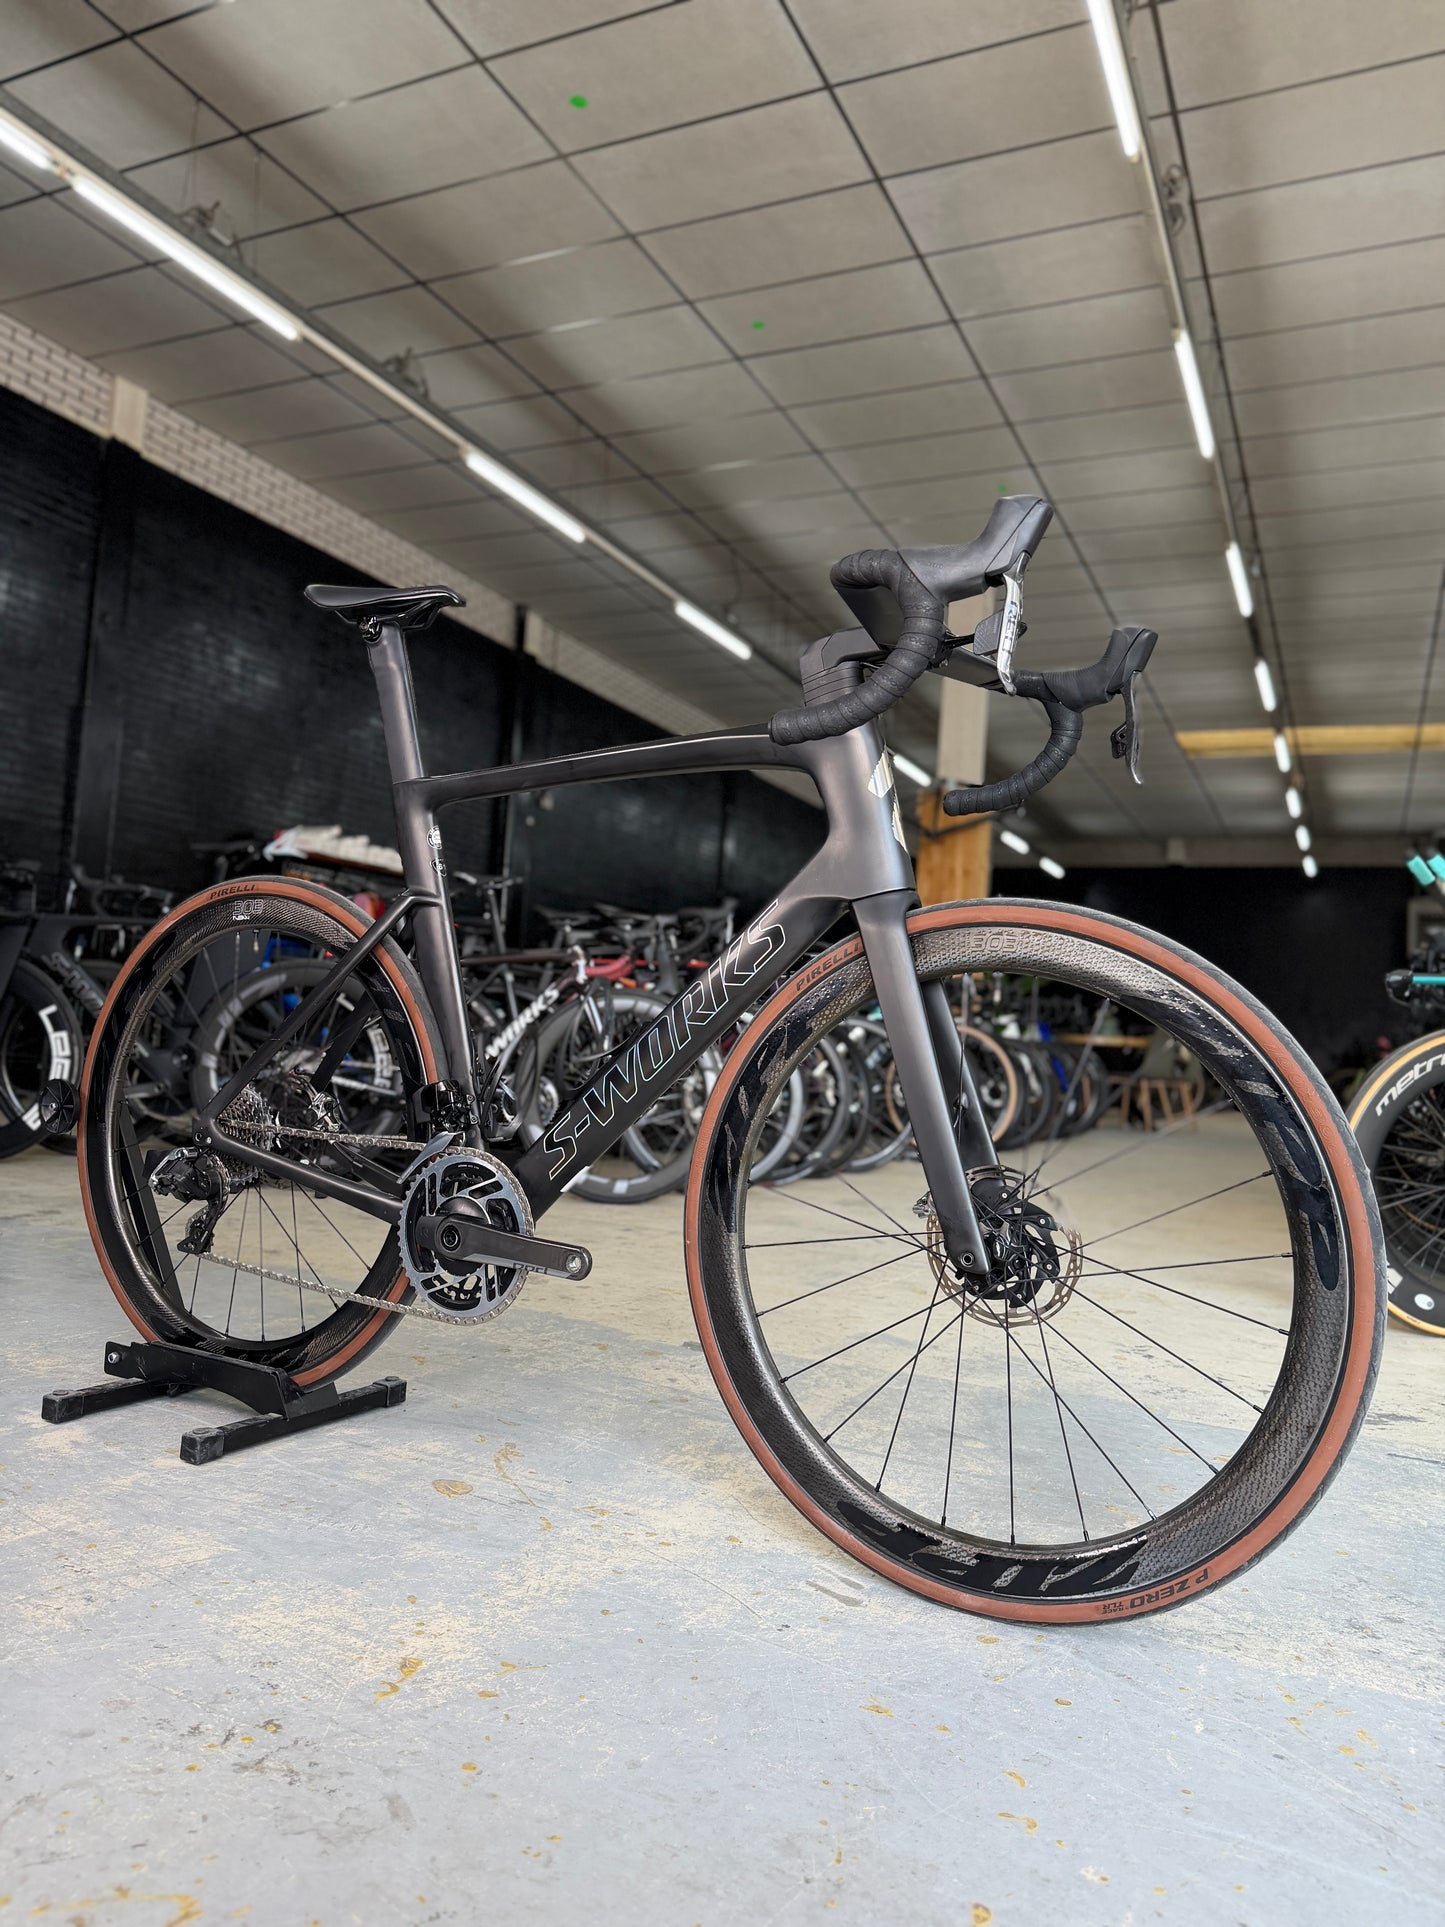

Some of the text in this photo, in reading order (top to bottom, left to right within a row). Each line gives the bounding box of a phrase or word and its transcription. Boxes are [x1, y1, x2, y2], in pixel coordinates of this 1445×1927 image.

[210, 884, 255, 900] PIRELLI
[233, 899, 263, 916] 303
[971, 933, 1020, 953] 303
[795, 942, 860, 991] PIRELLI
[543, 899, 786, 1181] S-WORKS
[1129, 1568, 1209, 1609] P ZERO
